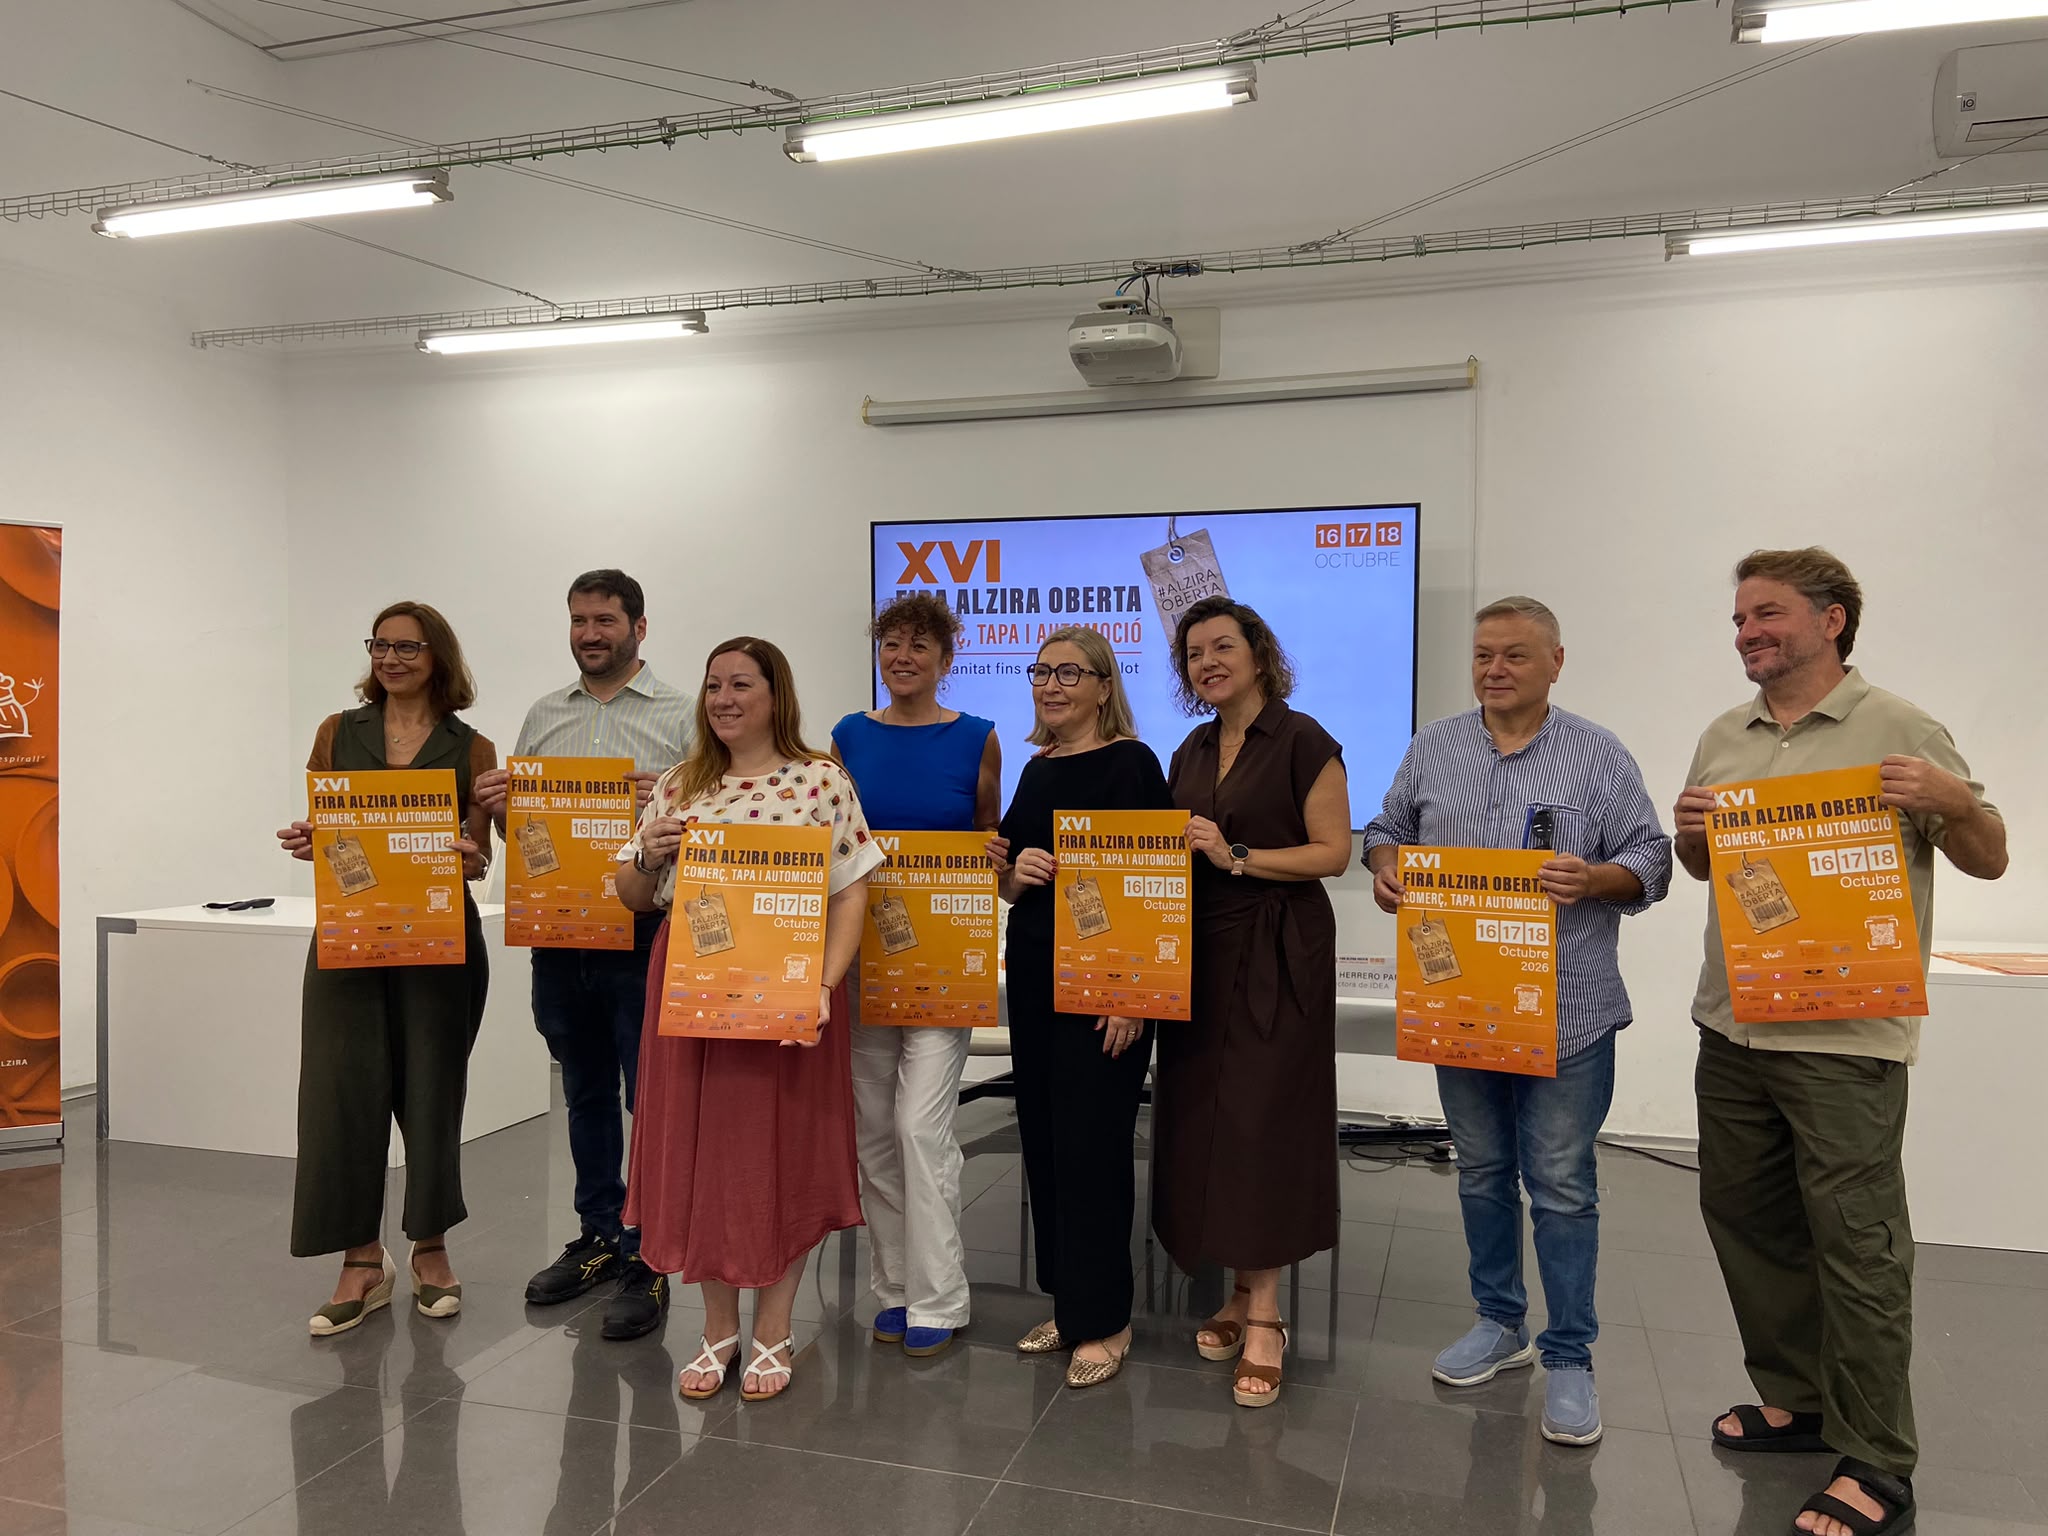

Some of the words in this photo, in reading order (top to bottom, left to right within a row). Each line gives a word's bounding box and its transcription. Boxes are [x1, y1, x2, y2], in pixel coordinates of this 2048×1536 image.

[1318, 529, 1339, 545] 16
[1348, 528, 1369, 544] 17
[1378, 526, 1399, 543] 18
[896, 539, 1001, 584] XVI
[1315, 551, 1400, 568] OCTUBRE
[1158, 569, 1217, 598] #ALZIRA
[956, 588, 1040, 614] ALZIRA
[1049, 586, 1142, 613] OBERTA
[1162, 582, 1222, 611] OBERTA
[977, 624, 1019, 645] TAPA
[1025, 623, 1030, 644] I
[1036, 617, 1142, 644] AOCIÓ
[951, 662, 991, 675] anitat
[996, 662, 1021, 675] fins
[1121, 662, 1139, 674] lot
[512, 762, 543, 776] XVI
[313, 777, 350, 792] XVI
[511, 779, 537, 793] FIRA
[541, 780, 582, 794] ALZIRA
[586, 781, 630, 794] OBERTA
[315, 795, 345, 809] FIRA
[350, 794, 397, 809] ALZIRA
[402, 793, 452, 808] OBERTA
[512, 796, 549, 810] COMERÇ,
[551, 797, 572, 809] TAPA
[580, 795, 630, 810] AUTOMOCIÓ
[1713, 788, 1756, 808] XVI
[316, 812, 360, 826] COMERÇ,
[362, 812, 387, 824] TAPA
[396, 809, 454, 823] AUTOMOCIÓ
[1712, 811, 1751, 829] FIRA
[1756, 802, 1817, 825] ALZIRA
[1821, 795, 1889, 817] OBERTA
[573, 824, 589, 835] 16
[593, 824, 607, 835] 17
[613, 824, 629, 836] 18
[1059, 817, 1091, 831] XVI
[1715, 830, 1771, 848] COMERÇ,
[1773, 825, 1804, 842] TAPA
[1816, 814, 1892, 838] AUTOMOCIÓ
[390, 837, 408, 850] 16
[413, 836, 430, 850] 17
[436, 836, 453, 849] 18
[688, 829, 725, 845] XVI
[1059, 835, 1086, 848] FIRA
[1090, 835, 1134, 849] ALZIRA
[1138, 836, 1186, 850] OBERTA
[411, 854, 456, 864] Octubre
[685, 847, 717, 863] FIRA
[720, 849, 769, 865] ALZIRA
[773, 851, 824, 867] OBERTA
[898, 855, 941, 869] ALZIRA
[946, 855, 993, 869] OBERTA
[1060, 853, 1099, 867] COMERÇ,
[1101, 853, 1124, 865] TAPA
[1132, 852, 1186, 866] AUTOMOCIÓ
[1404, 852, 1441, 868] XVI
[1811, 856, 1834, 872] 16
[1841, 853, 1862, 869] 17
[1870, 850, 1894, 866] 18
[431, 866, 456, 875] 2026
[683, 865, 728, 883] COMERÇ,
[732, 868, 756, 881] TAPA
[765, 869, 824, 884] AUTOMOCIÓ
[908, 872, 931, 884] TAPA
[939, 870, 993, 885] AUTOMOCIÓ
[1126, 881, 1142, 893] 16
[1146, 881, 1162, 894] 17
[1168, 882, 1184, 894] 18
[1403, 872, 1434, 887] FIRA
[1438, 873, 1488, 890] ALZIRA
[1840, 874, 1900, 889] Octubre
[1403, 891, 1448, 908] COMERÇ,
[1450, 893, 1475, 907] TAPA
[1486, 896, 1549, 911] AUTOMOCIÓ
[1868, 888, 1903, 901] 2026
[756, 897, 773, 911] 16
[780, 898, 797, 912] 17
[802, 899, 820, 913] 18
[933, 899, 949, 910] 16
[954, 899, 969, 910] 17
[975, 899, 991, 911] 18
[1144, 900, 1186, 911] Octubre
[774, 918, 820, 929] Octubre
[951, 916, 993, 926] Octubre
[1162, 914, 1186, 923] 2026
[793, 931, 819, 942] 2026
[969, 929, 993, 938] 2026
[1478, 924, 1496, 938] 16
[1503, 926, 1520, 940] 17
[1527, 927, 1546, 941] 18
[1499, 945, 1549, 959] Octubre
[1521, 962, 1549, 973] 2026
[1340, 971, 1380, 980] HERRERO
[0, 1058, 28, 1067] LZIRA
